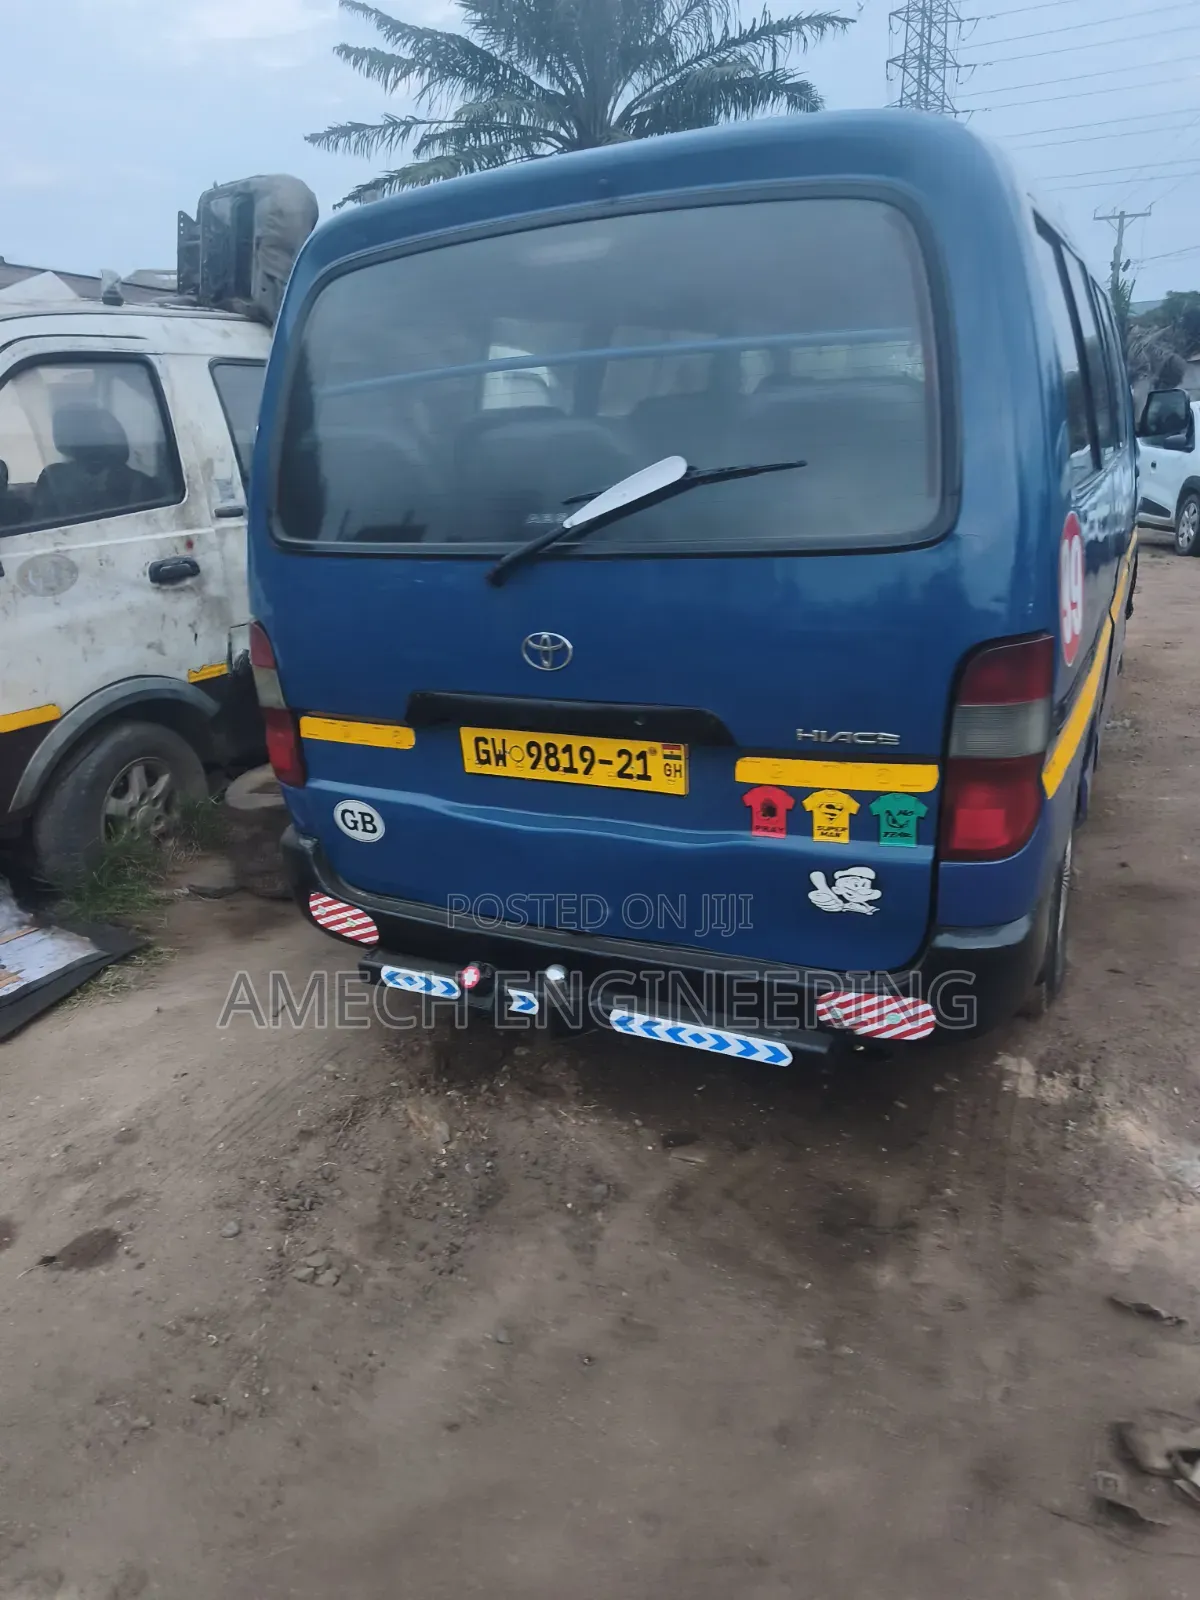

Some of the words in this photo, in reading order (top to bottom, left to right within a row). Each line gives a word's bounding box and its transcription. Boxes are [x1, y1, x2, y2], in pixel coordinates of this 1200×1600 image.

[796, 728, 901, 745] HIACE
[473, 736, 507, 767] GW
[525, 740, 652, 782] 9819-21
[663, 762, 683, 779] GH
[340, 808, 378, 834] GB
